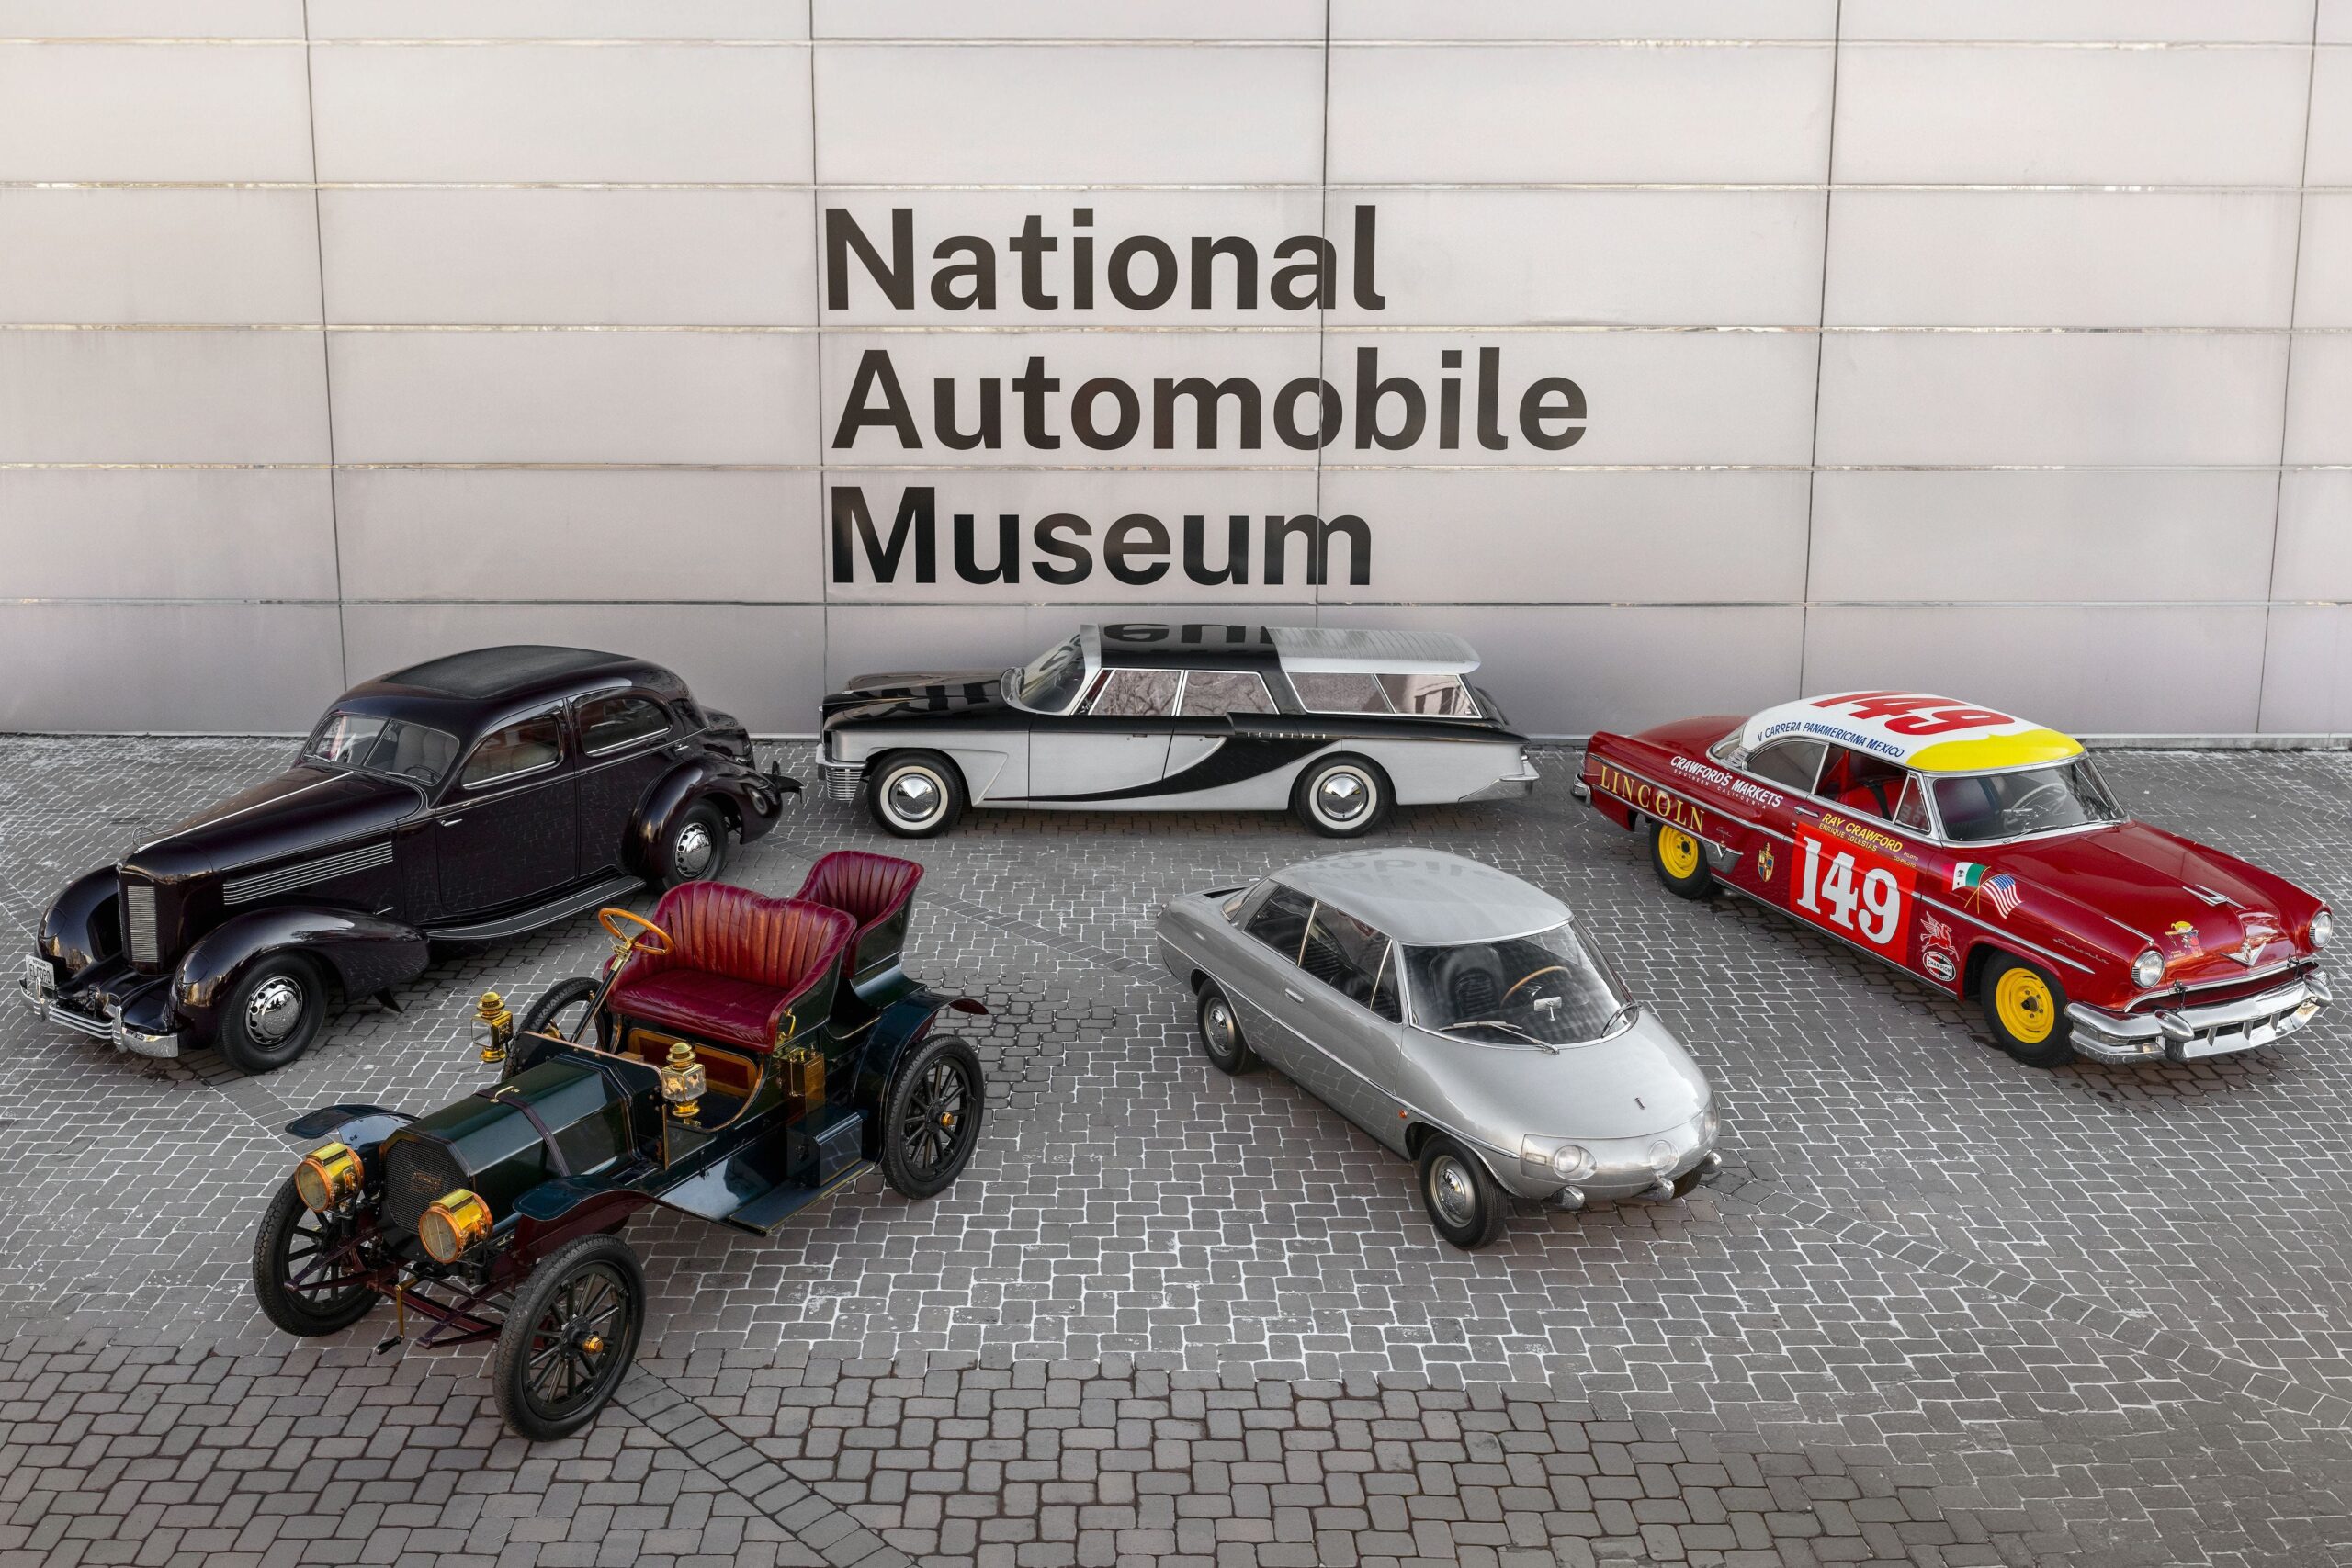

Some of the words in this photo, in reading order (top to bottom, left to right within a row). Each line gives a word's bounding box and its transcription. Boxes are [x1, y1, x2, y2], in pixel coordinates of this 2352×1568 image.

[825, 205, 1385, 311] National
[831, 347, 1588, 450] Automobile
[831, 485, 1373, 586] Museum
[1808, 690, 2016, 736] 149
[1757, 732, 1763, 742] V
[1765, 721, 1801, 738] CARRERA
[1803, 722, 1867, 746] PANAMERICANA
[1866, 739, 1905, 758] MEXICO
[1600, 765, 1705, 833] LINCOLN
[1670, 755, 1733, 787] CRAWFORD'S
[1731, 779, 1784, 807] MARKETS
[1674, 768, 1710, 786] SOUTHERN
[1717, 785, 1766, 809] CALIFORNIA
[1819, 822, 1846, 839] ENRIQUE
[1847, 834, 1878, 852] IGLESIAS
[1822, 813, 1846, 829] RAY
[1845, 822, 1904, 852] CRAWFORD
[1797, 836, 1901, 944] 149
[1928, 959, 1951, 974] CHAMPION
